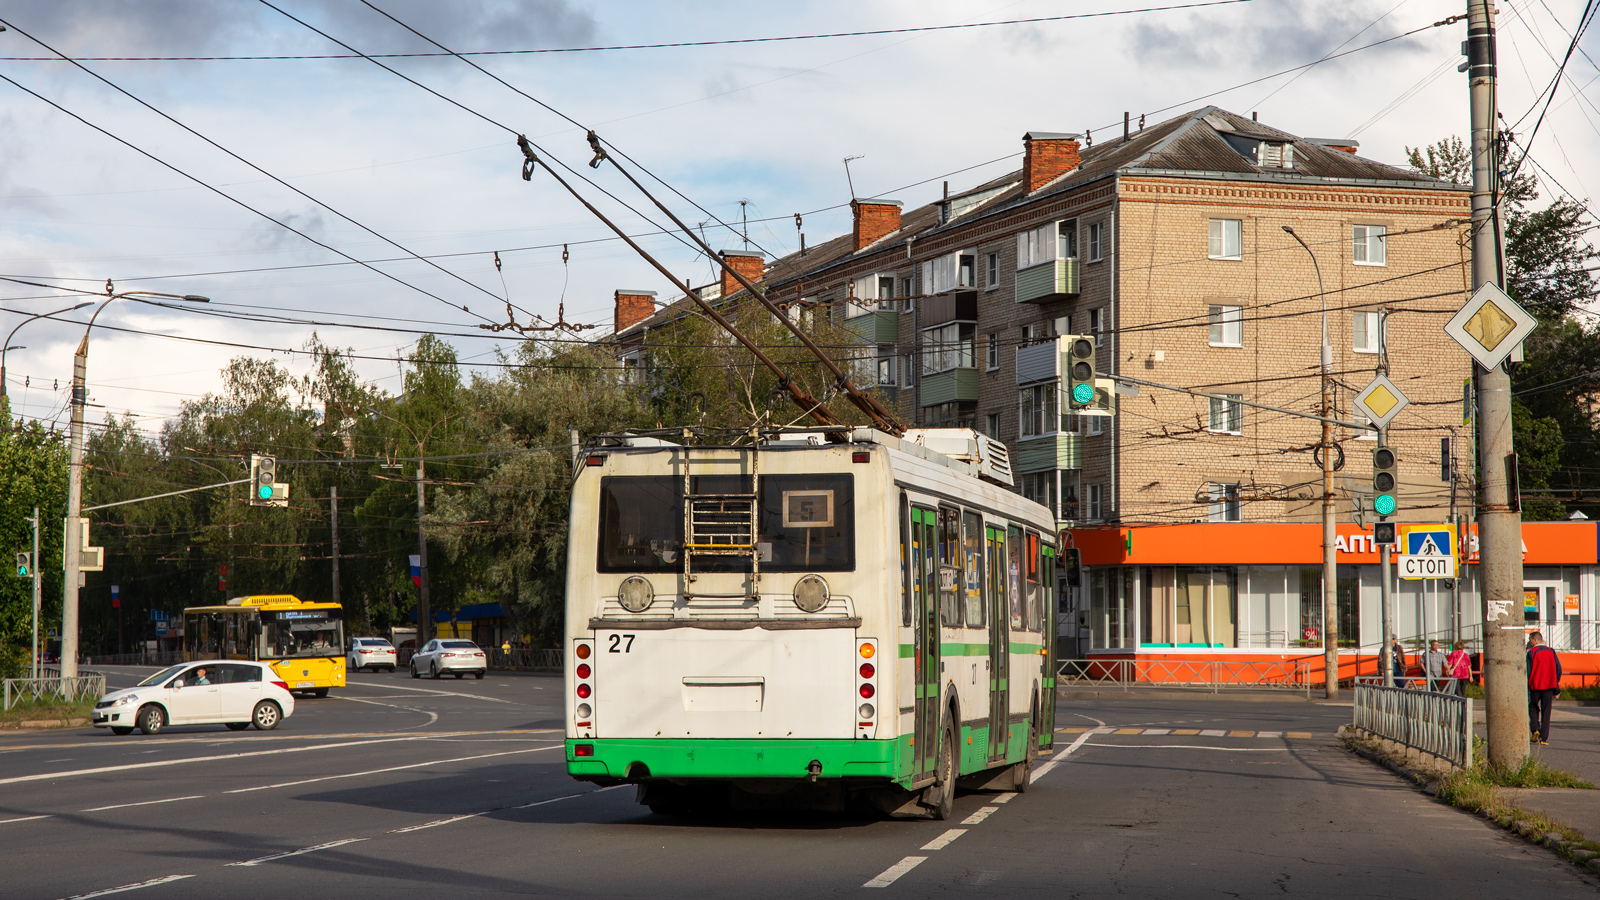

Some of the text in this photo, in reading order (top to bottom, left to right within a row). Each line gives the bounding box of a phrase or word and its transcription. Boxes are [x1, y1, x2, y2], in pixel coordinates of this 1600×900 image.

[800, 501, 814, 521] 5
[1335, 535, 1402, 552] АПТ
[1406, 558, 1447, 574] СТОП
[608, 633, 636, 654] 27
[971, 663, 977, 685] 27
